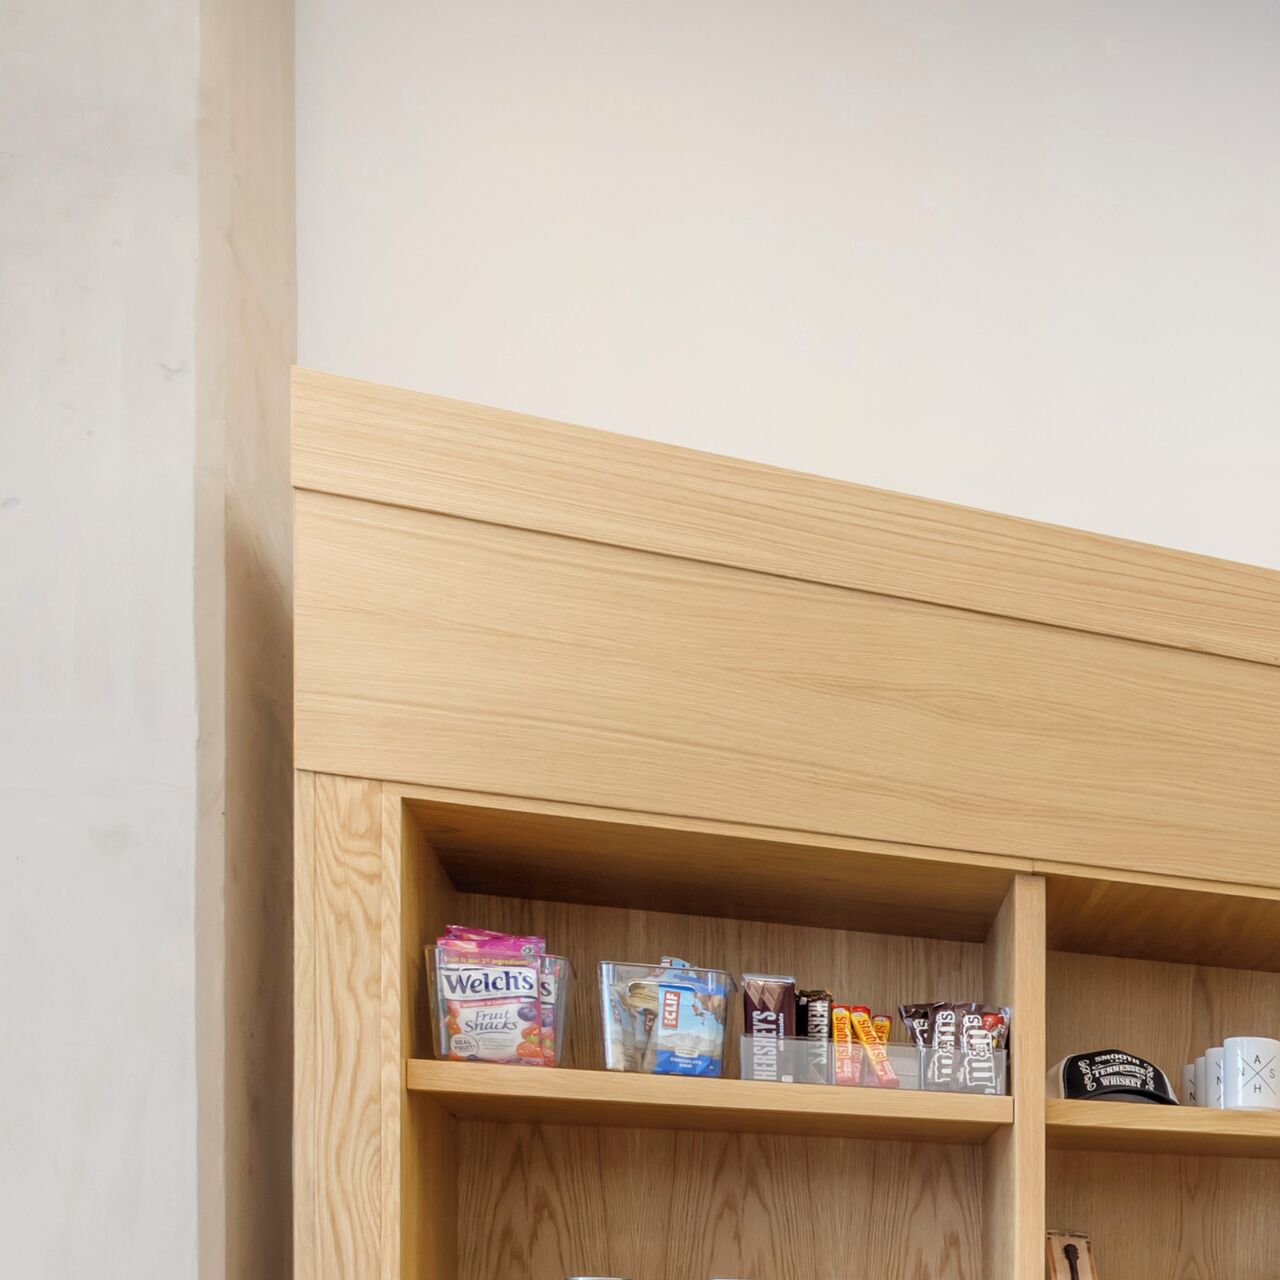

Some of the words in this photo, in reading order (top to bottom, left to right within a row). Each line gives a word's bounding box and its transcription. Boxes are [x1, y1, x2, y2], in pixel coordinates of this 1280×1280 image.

[443, 971, 534, 994] Welch's
[664, 992, 679, 1020] CLIF
[475, 1009, 512, 1022] Fruit
[464, 1021, 518, 1033] Snacks
[752, 1010, 777, 1080] HERSHEY'S
[1094, 1053, 1140, 1064] SMOOTH
[1092, 1064, 1147, 1077] TENNESSEE
[1100, 1075, 1142, 1087] WHISKEY
